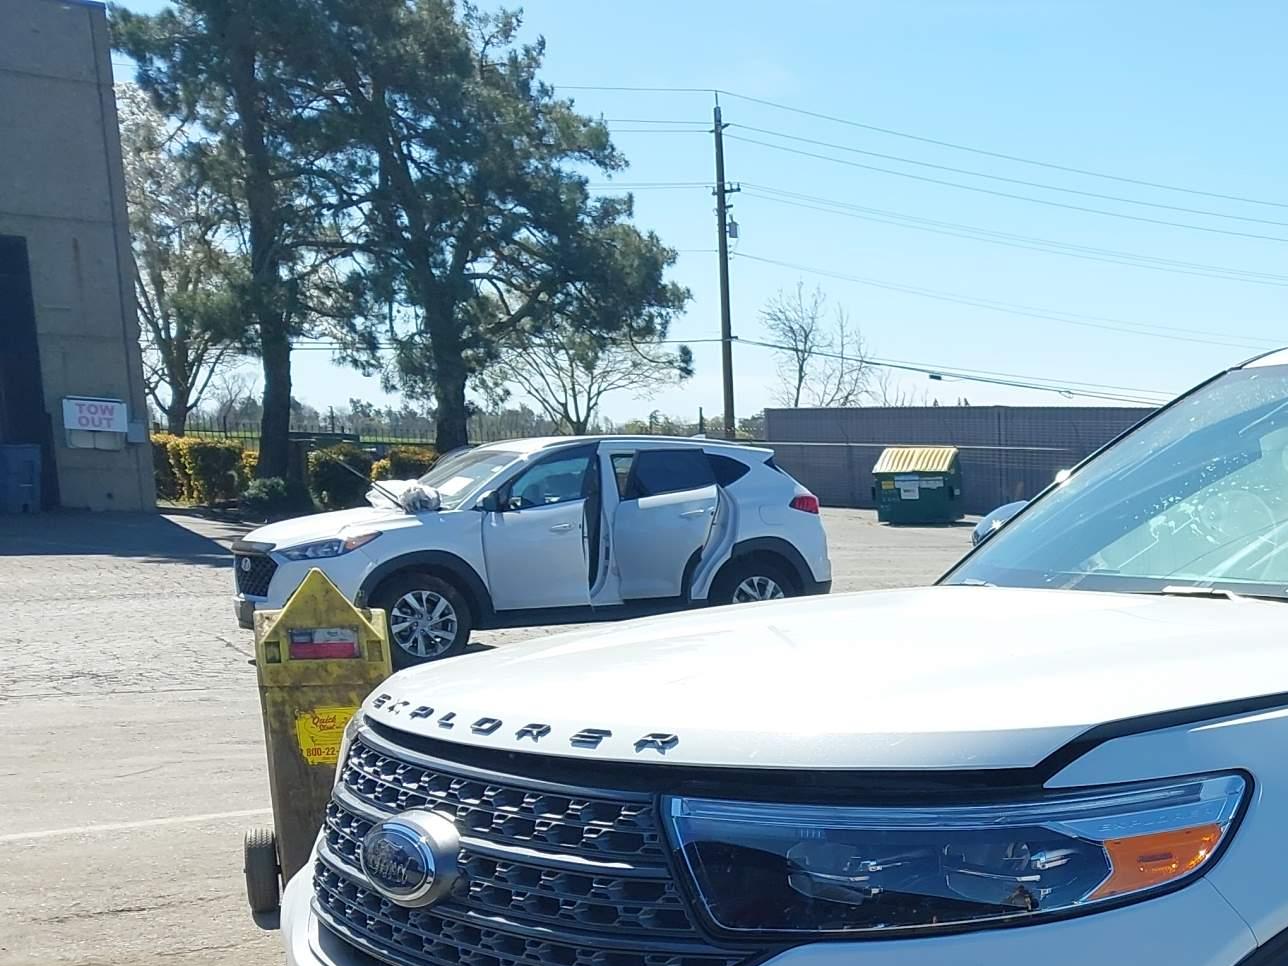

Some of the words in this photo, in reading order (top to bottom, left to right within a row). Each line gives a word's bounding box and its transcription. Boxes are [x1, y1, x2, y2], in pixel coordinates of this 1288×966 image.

[75, 403, 114, 416] TOW
[79, 416, 114, 428] OUT
[372, 693, 679, 755] EXPLORER
